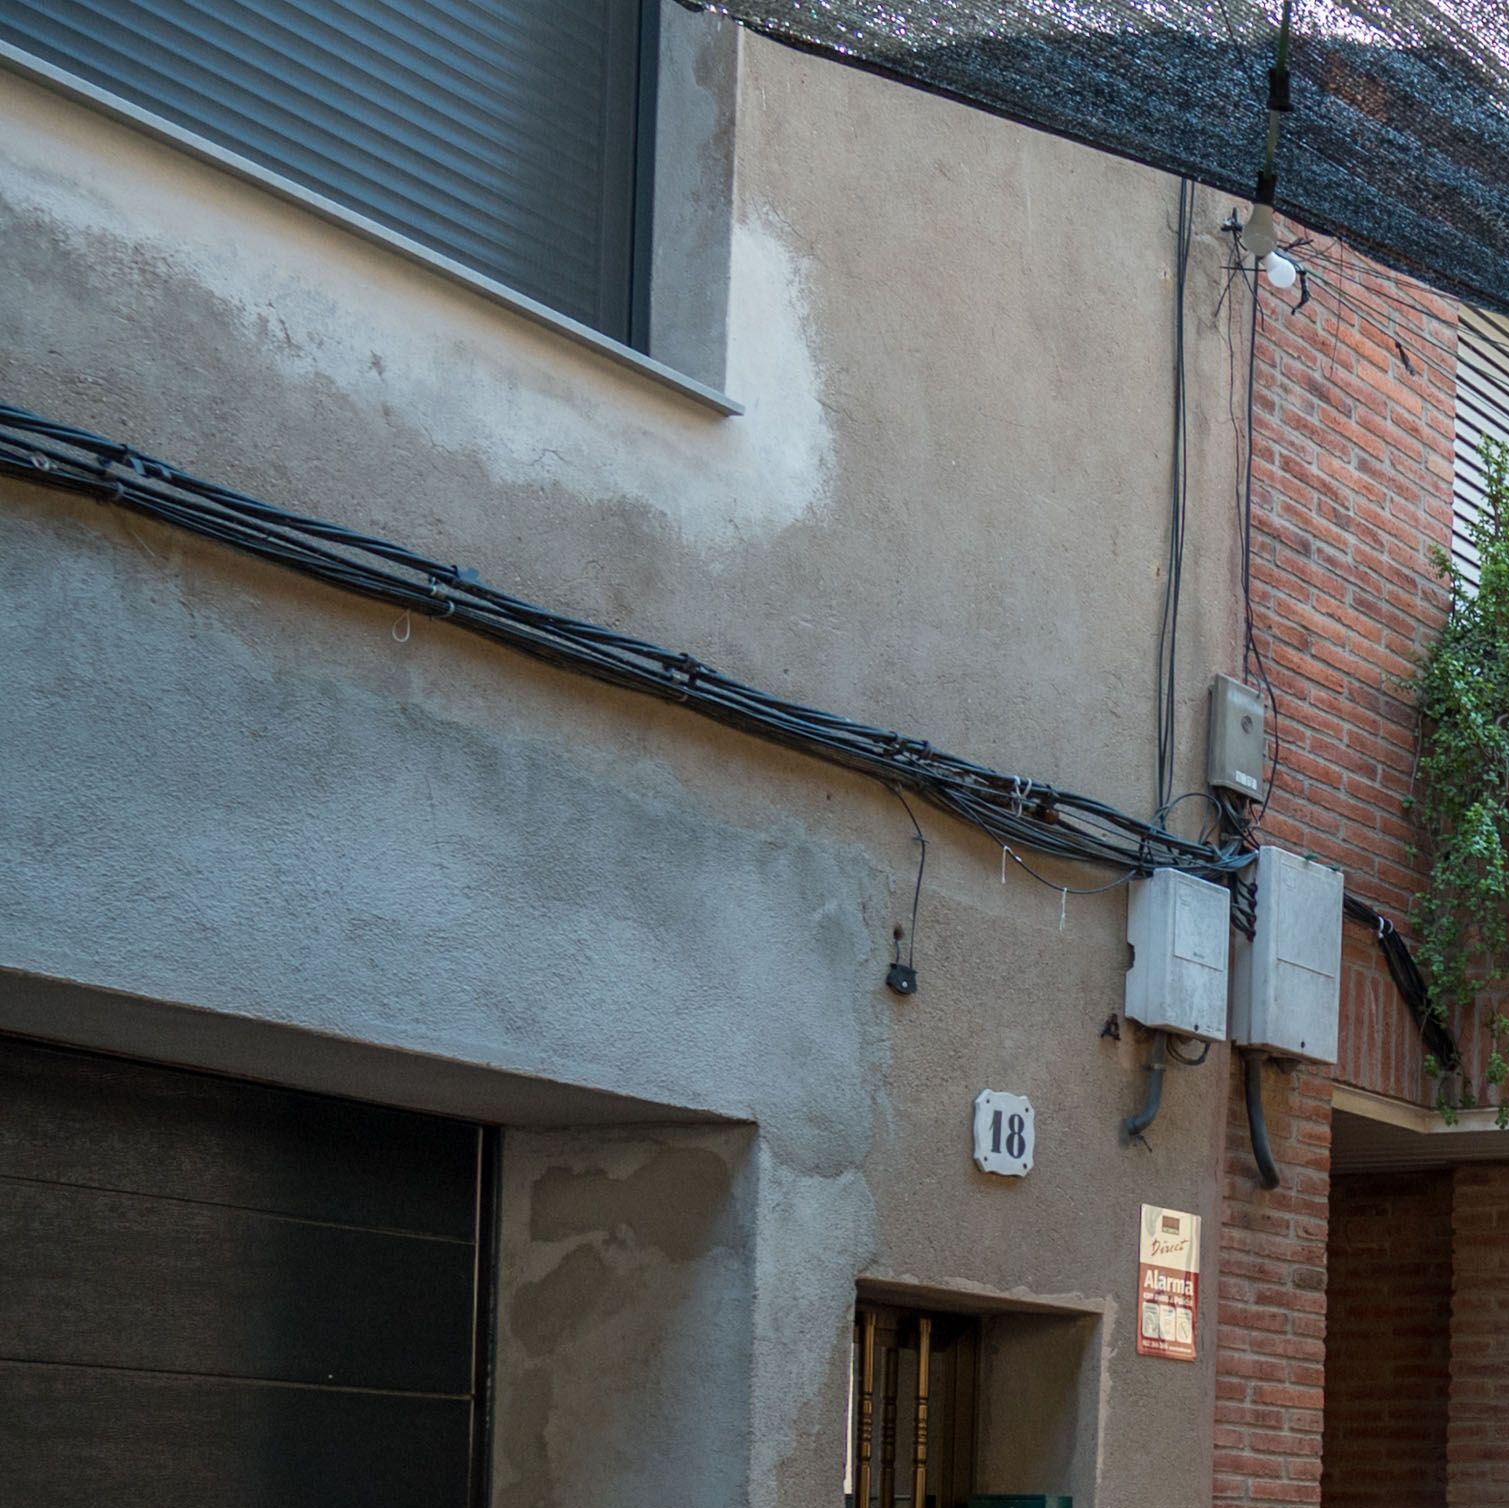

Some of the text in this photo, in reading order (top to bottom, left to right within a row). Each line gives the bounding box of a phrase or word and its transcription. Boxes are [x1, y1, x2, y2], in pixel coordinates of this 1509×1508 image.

[989, 1110, 1026, 1159] 18
[1151, 1238, 1189, 1258] Direct
[1144, 1269, 1194, 1297] Alarma
